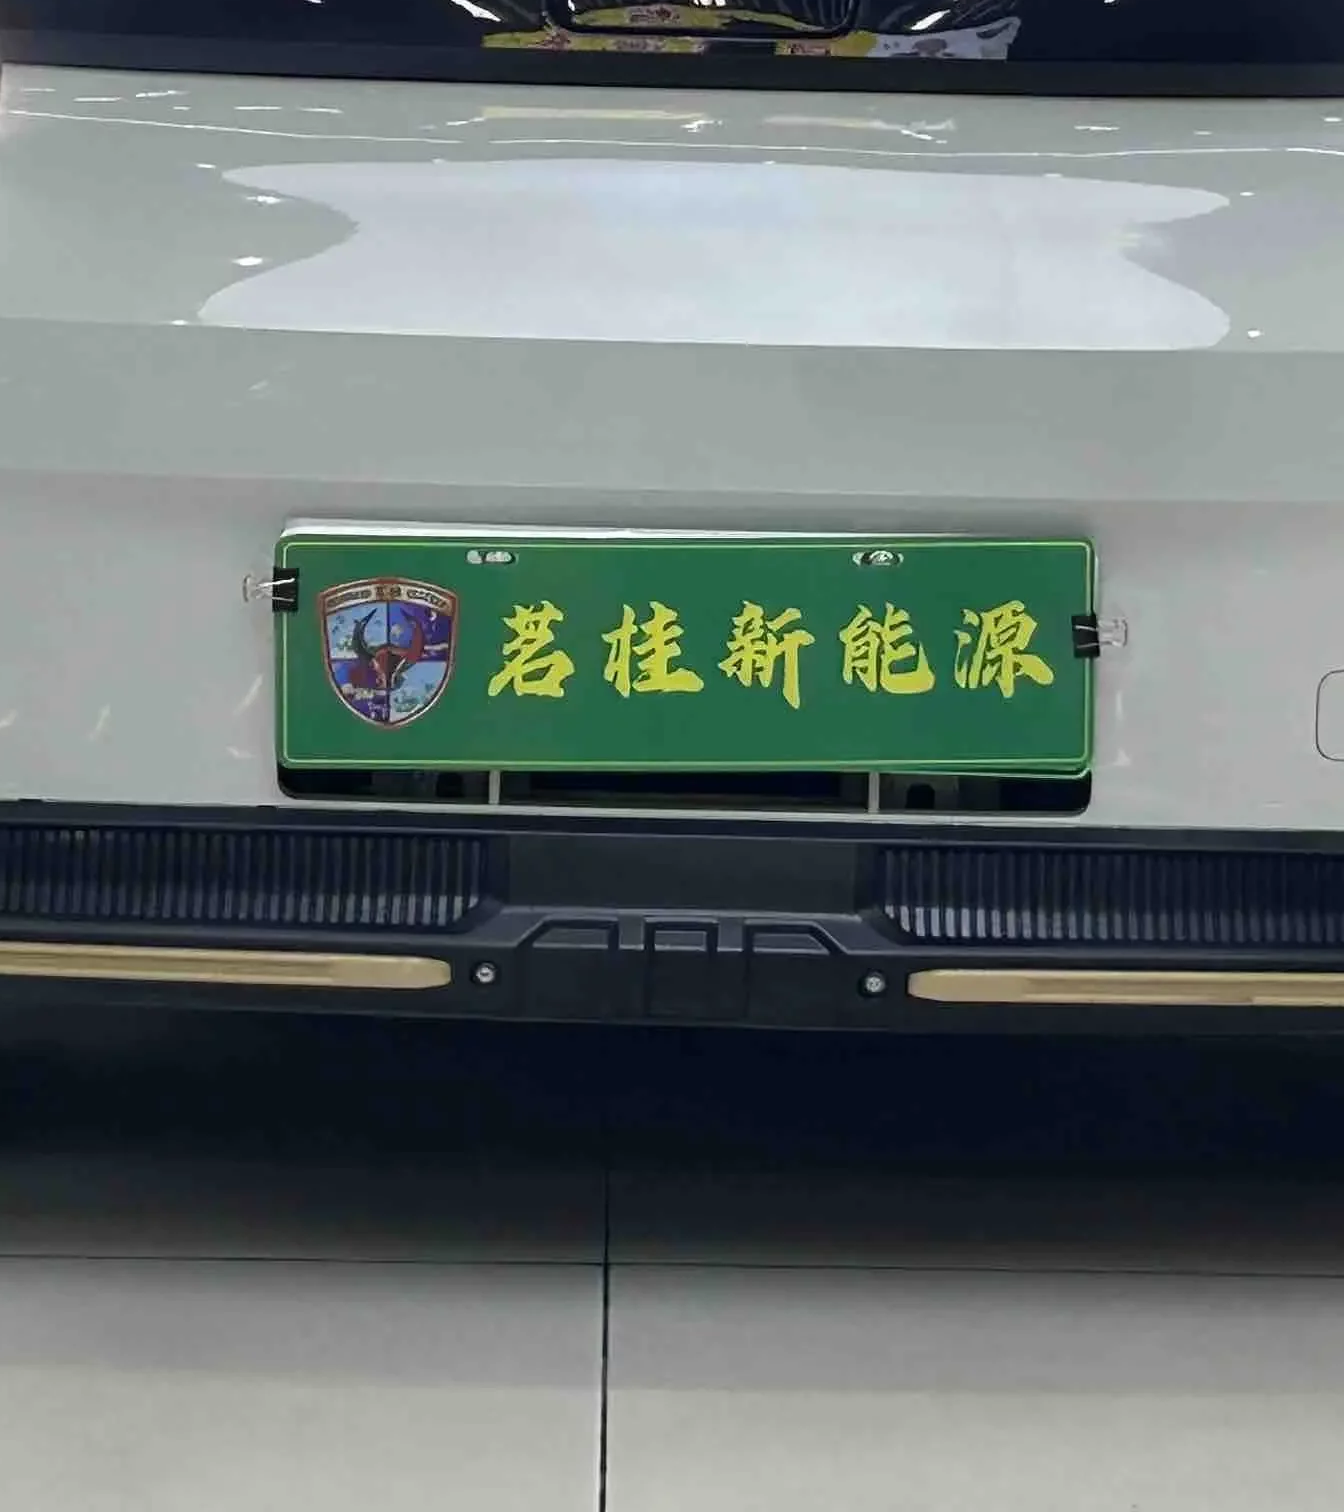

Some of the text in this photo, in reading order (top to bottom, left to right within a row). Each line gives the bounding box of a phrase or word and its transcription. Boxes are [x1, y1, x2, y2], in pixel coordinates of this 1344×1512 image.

[488, 600, 1053, 709] 茗桂新能源
